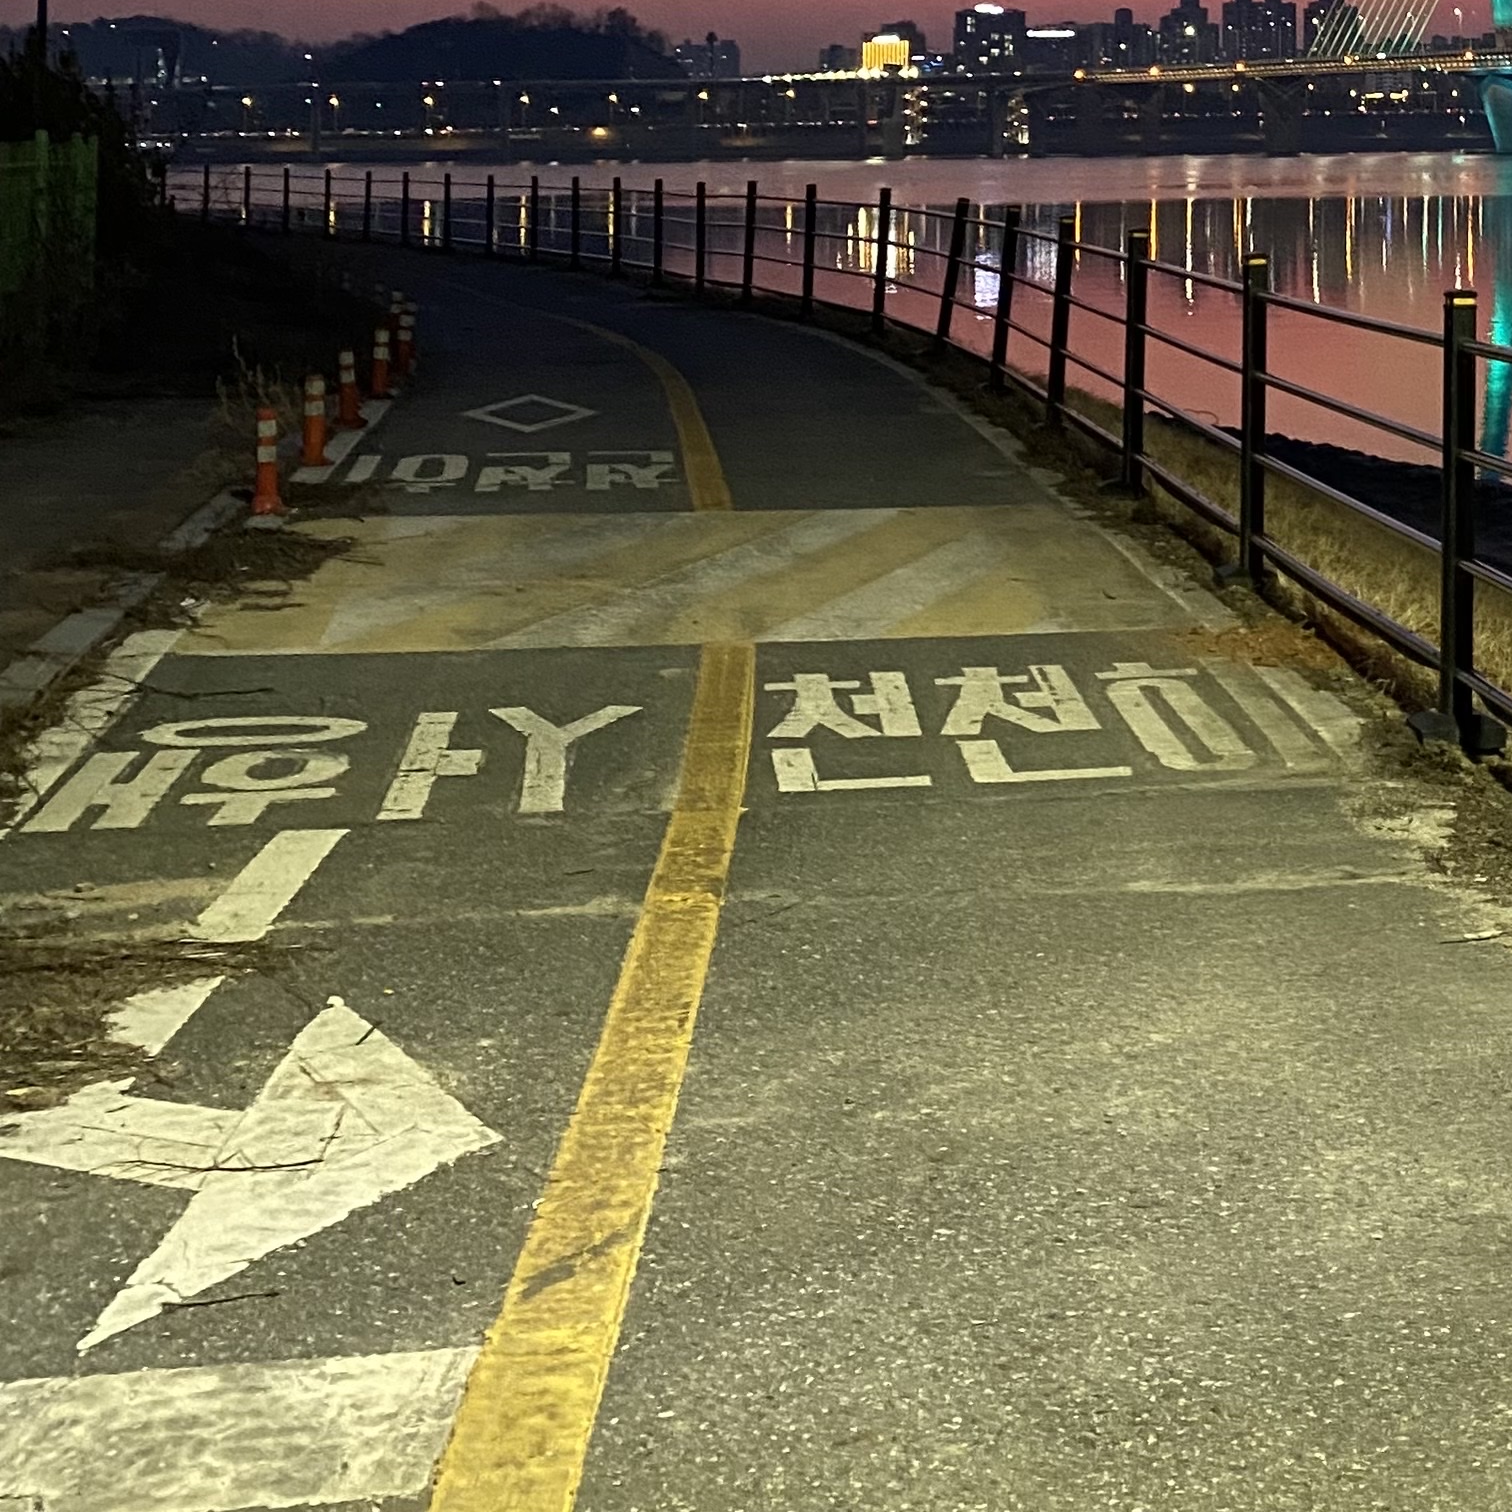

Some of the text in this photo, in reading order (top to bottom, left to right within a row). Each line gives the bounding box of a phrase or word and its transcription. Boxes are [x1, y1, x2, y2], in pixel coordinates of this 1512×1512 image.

[343, 449, 682, 493] 천천히
[19, 704, 644, 834] 서행
[763, 661, 1345, 793] 천천히
